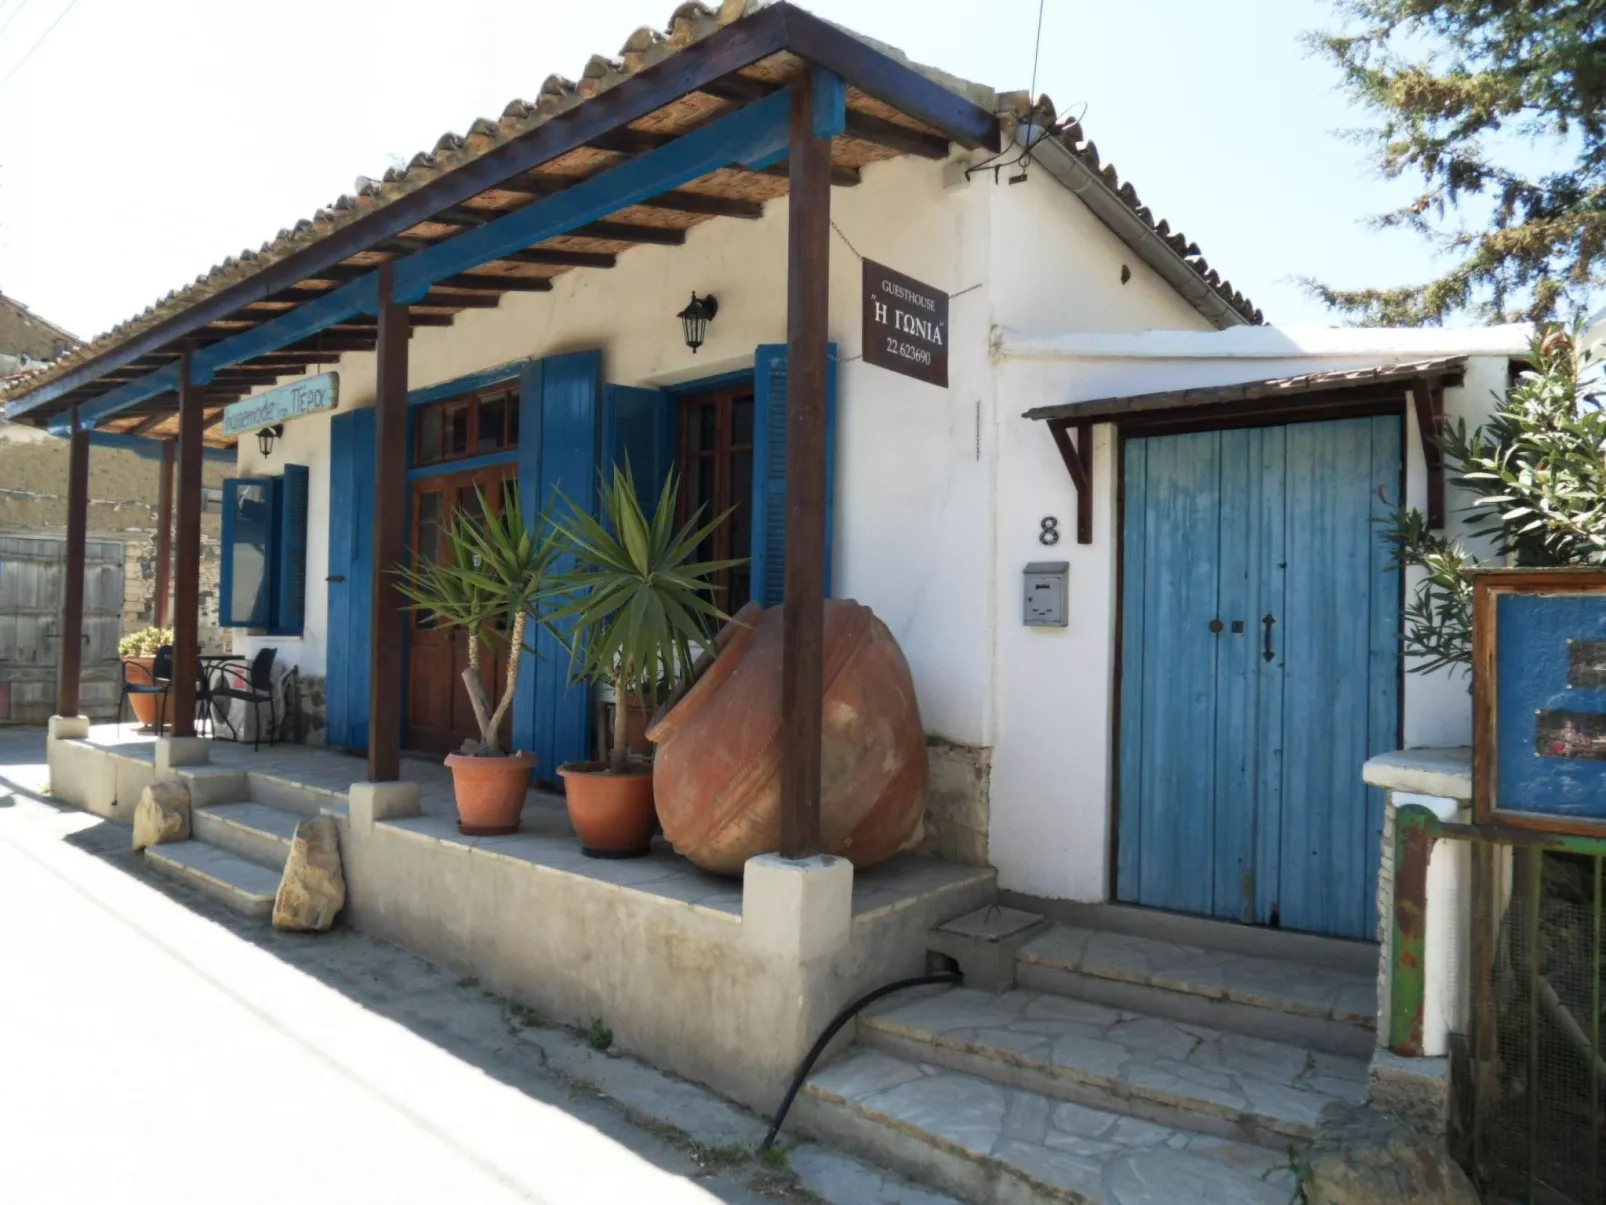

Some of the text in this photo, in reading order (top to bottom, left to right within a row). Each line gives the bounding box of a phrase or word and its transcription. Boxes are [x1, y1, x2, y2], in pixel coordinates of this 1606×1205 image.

[882, 280, 936, 312] GUESTHOUSE
[886, 337, 932, 366] 22 623690
[1039, 516, 1060, 546] 8
